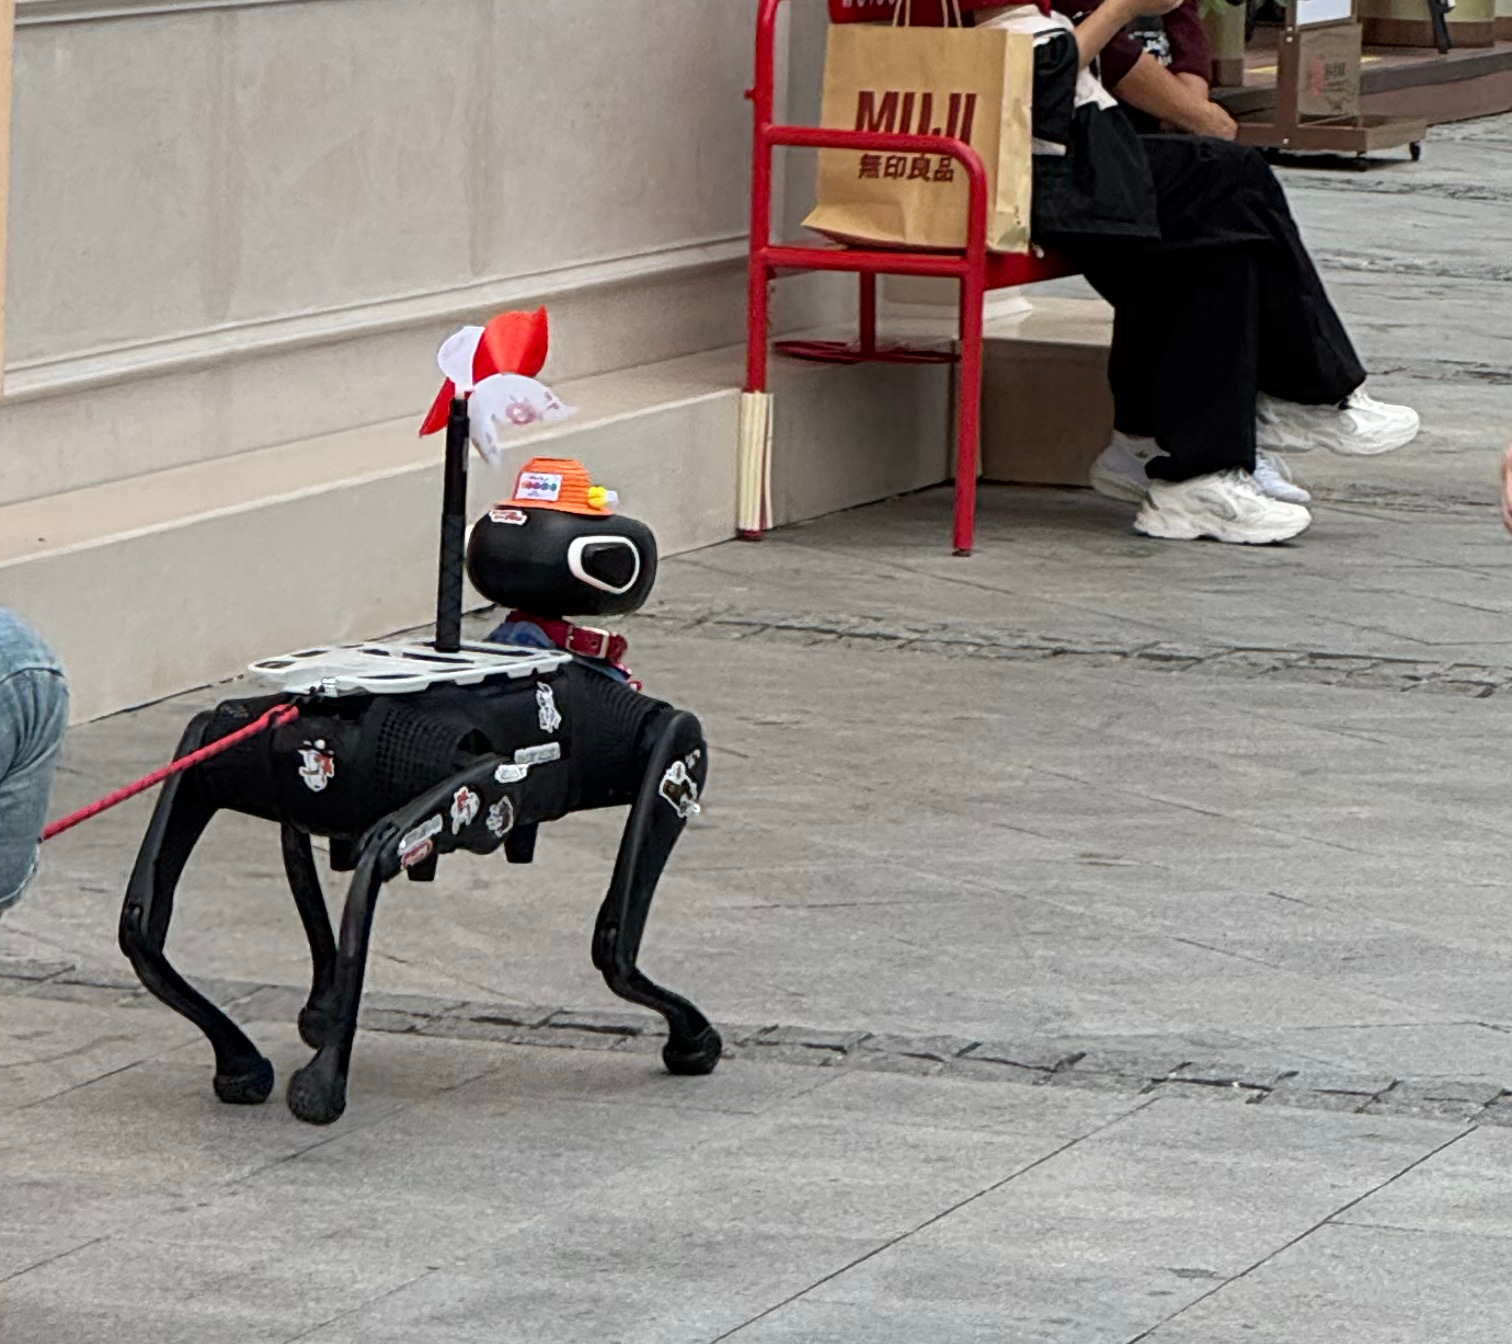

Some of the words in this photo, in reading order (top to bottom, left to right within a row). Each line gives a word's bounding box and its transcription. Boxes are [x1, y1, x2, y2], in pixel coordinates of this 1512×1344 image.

[855, 90, 978, 146] MUJI
[858, 153, 955, 182] 無印良品
